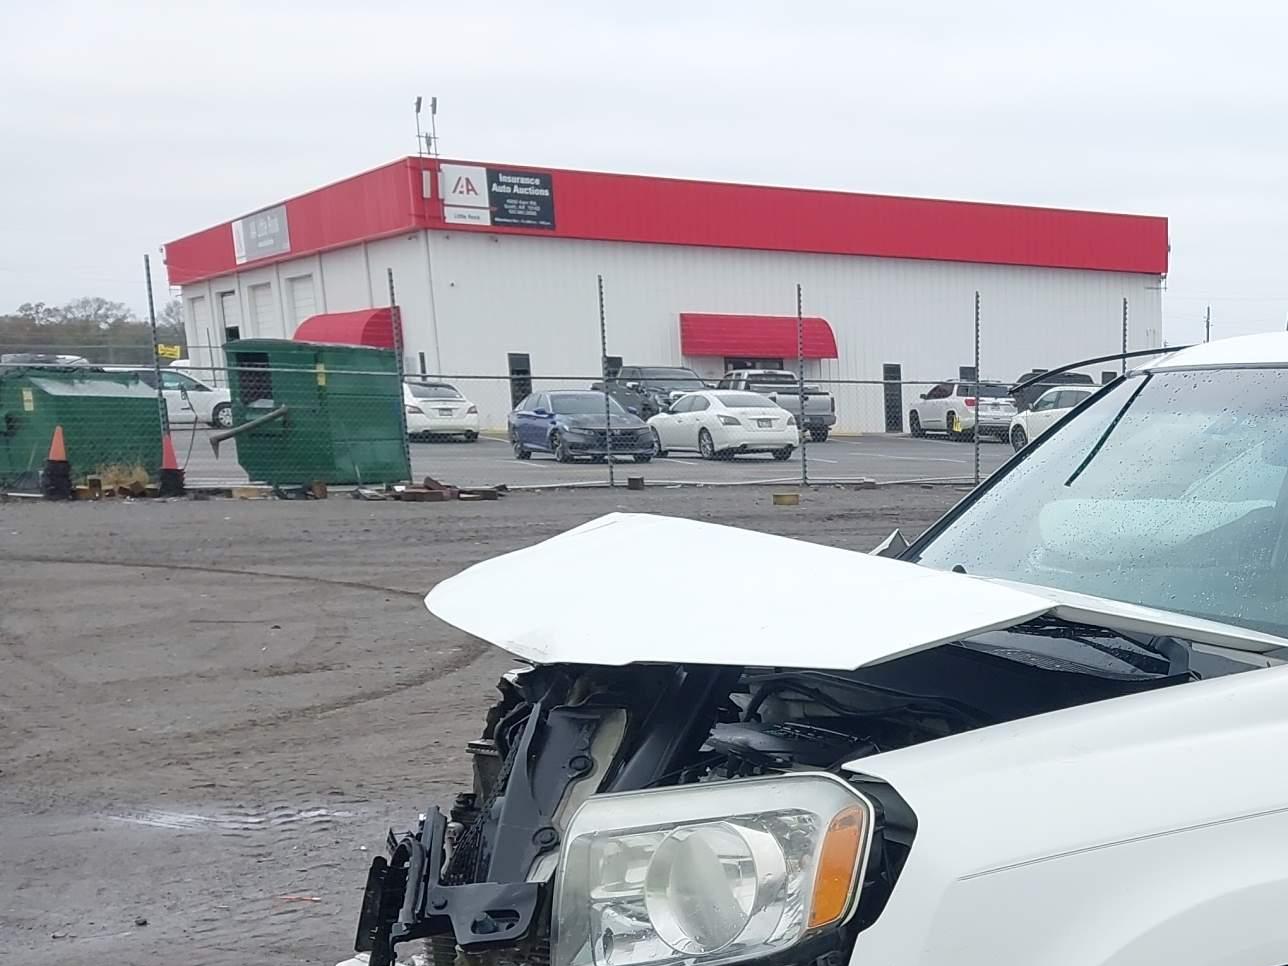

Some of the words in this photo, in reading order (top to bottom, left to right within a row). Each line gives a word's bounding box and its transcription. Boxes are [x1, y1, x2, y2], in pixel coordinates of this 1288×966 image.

[499, 173, 540, 185] Insurance
[492, 183, 512, 194] Auto
[513, 184, 549, 196] Auctions
